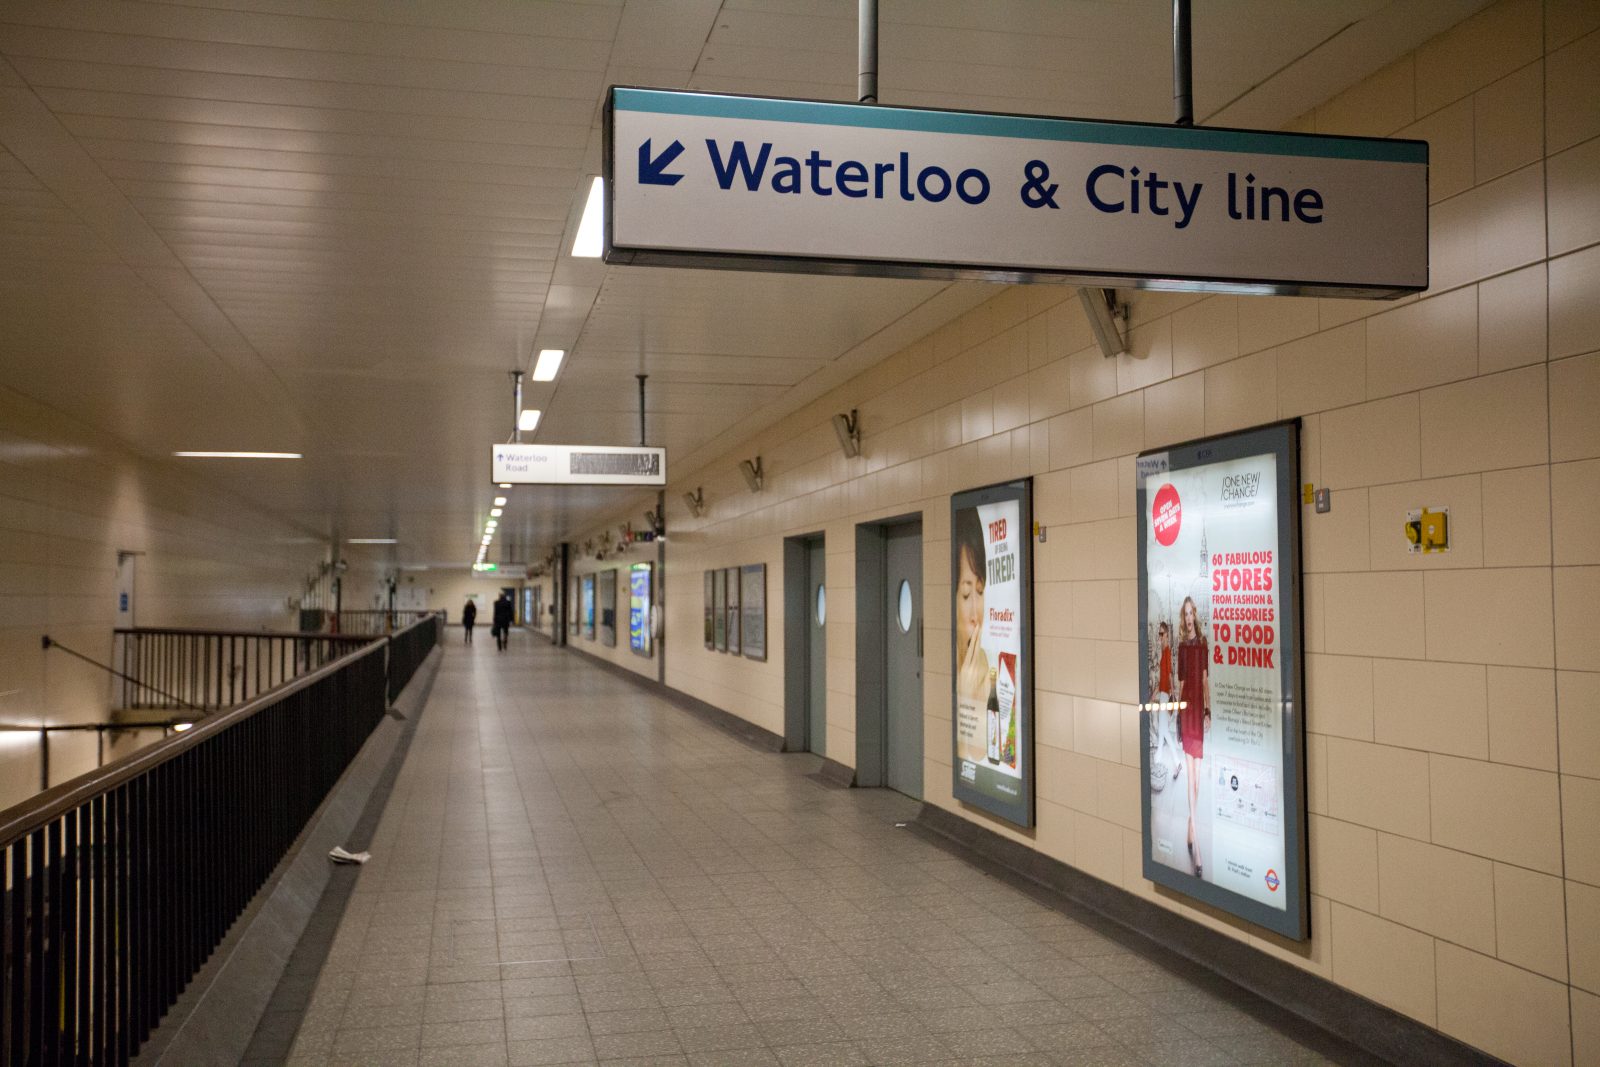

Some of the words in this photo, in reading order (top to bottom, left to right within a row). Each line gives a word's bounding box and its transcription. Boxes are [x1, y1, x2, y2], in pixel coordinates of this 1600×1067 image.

[705, 138, 991, 205] Waterloo
[1019, 159, 1061, 210] &
[1085, 163, 1203, 229] City
[1227, 172, 1325, 224] line
[506, 454, 547, 462] Waterloo
[506, 464, 528, 472] Road
[988, 518, 1007, 545] TIRED
[988, 553, 1016, 586] TIRED?
[1212, 553, 1223, 566] 60
[1225, 551, 1273, 565] FABULOUS
[1212, 567, 1273, 592] STORES
[1212, 594, 1232, 605] FROM
[1234, 594, 1265, 605] FASHION
[1267, 594, 1273, 605] &
[1213, 607, 1275, 622] ACCESSORIES
[1213, 623, 1231, 643] TO
[1235, 624, 1275, 645] FOOD
[1213, 645, 1224, 665] &
[1228, 646, 1275, 669] DRINK
